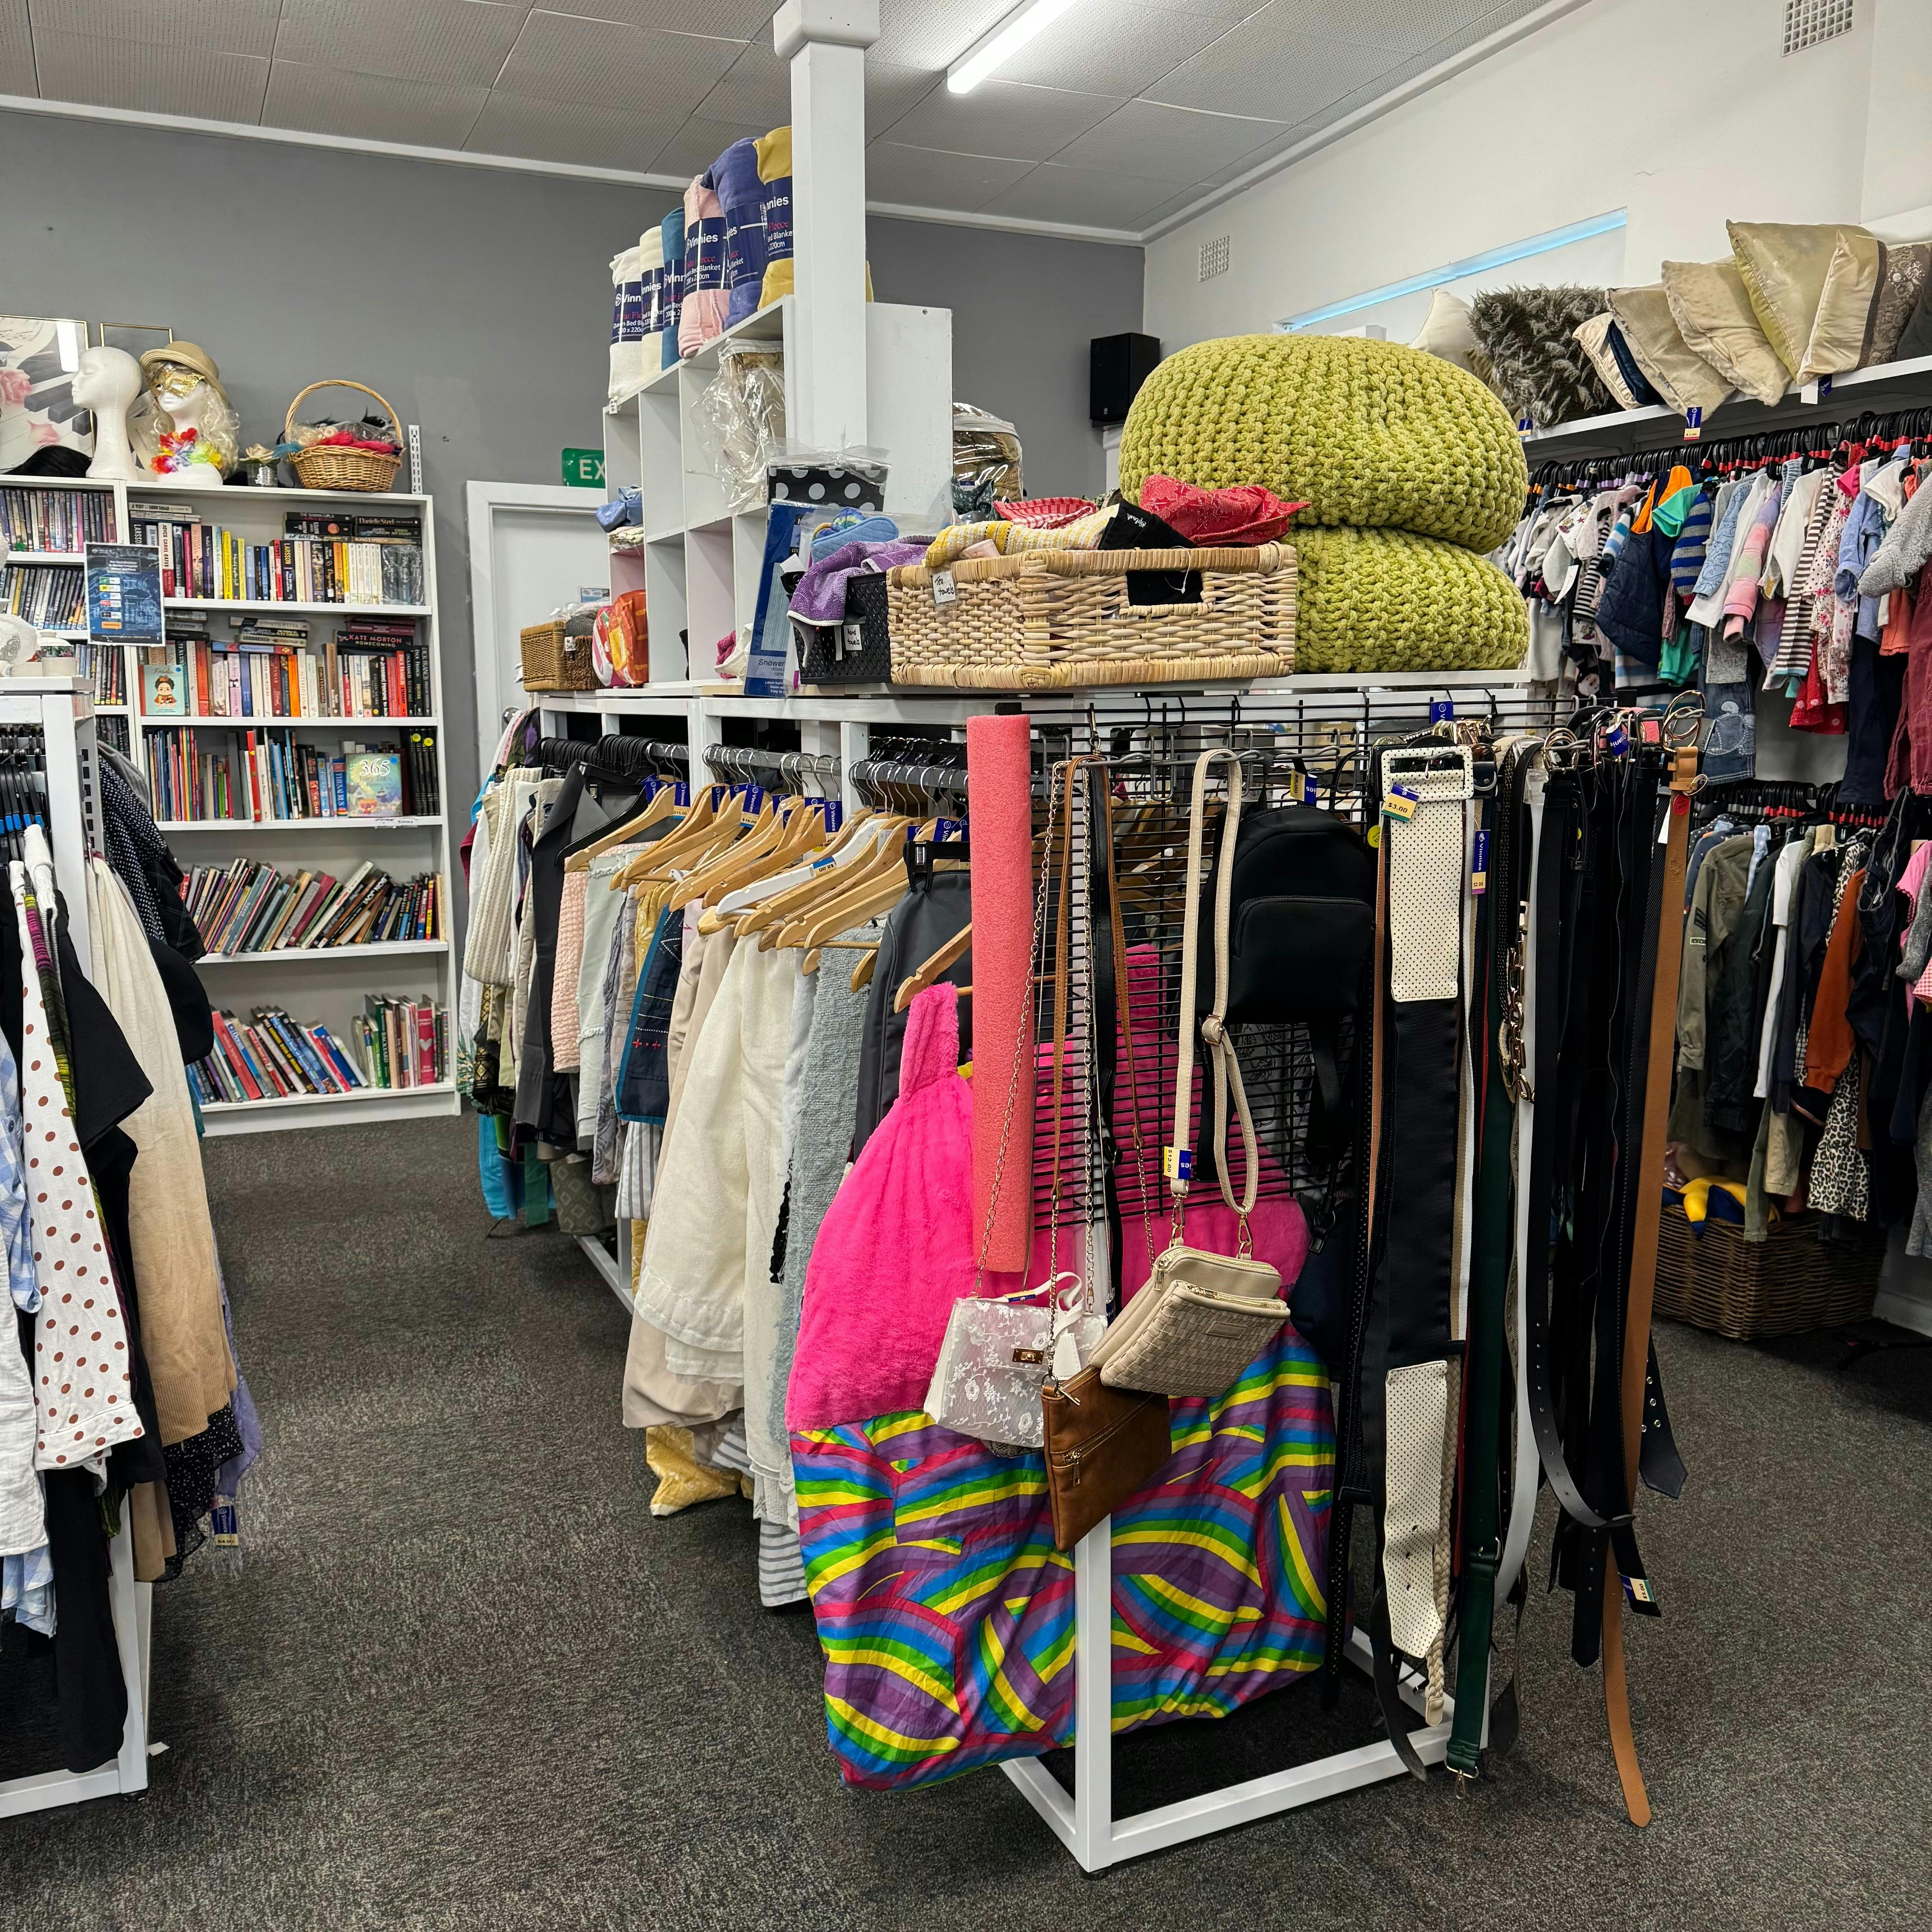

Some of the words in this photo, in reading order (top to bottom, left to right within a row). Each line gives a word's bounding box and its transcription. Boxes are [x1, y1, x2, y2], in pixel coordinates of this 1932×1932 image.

[580, 459, 605, 480] EX
[938, 583, 954, 596] towels
[759, 658, 785, 667] Shower
[359, 758, 390, 777] 365
[335, 772, 344, 809] THESAURUS
[749, 794, 757, 812] Vinnies
[1388, 802, 1408, 813] $3.00
[374, 877, 387, 891] BON
[363, 890, 375, 905] JOVI
[231, 1030, 245, 1050] Ocean
